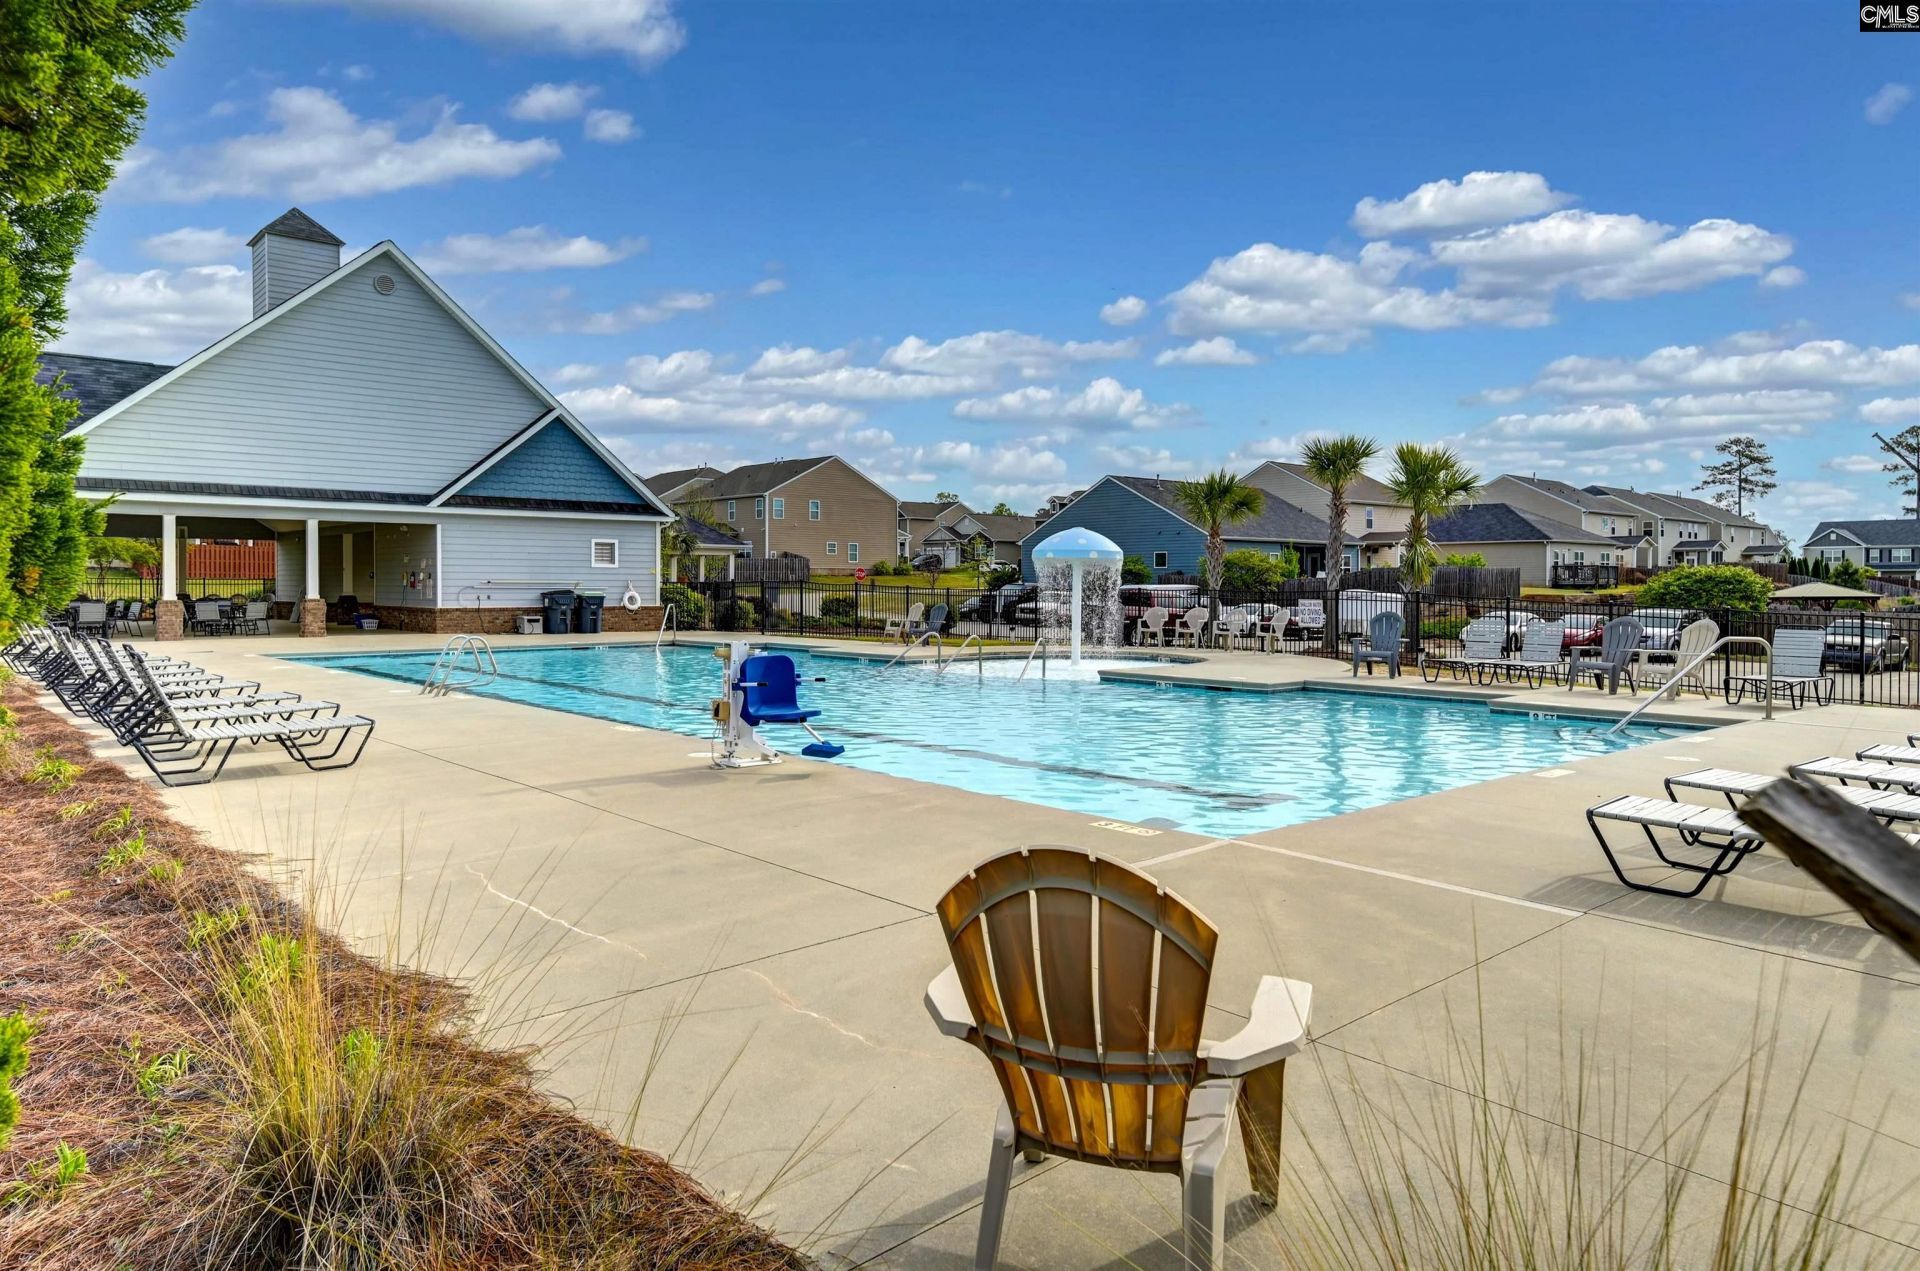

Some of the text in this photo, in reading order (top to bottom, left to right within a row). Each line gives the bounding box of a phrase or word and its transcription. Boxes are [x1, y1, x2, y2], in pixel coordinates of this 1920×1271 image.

[1300, 608, 1321, 616] NO DIVING
[1301, 616, 1320, 624] ALLOWED
